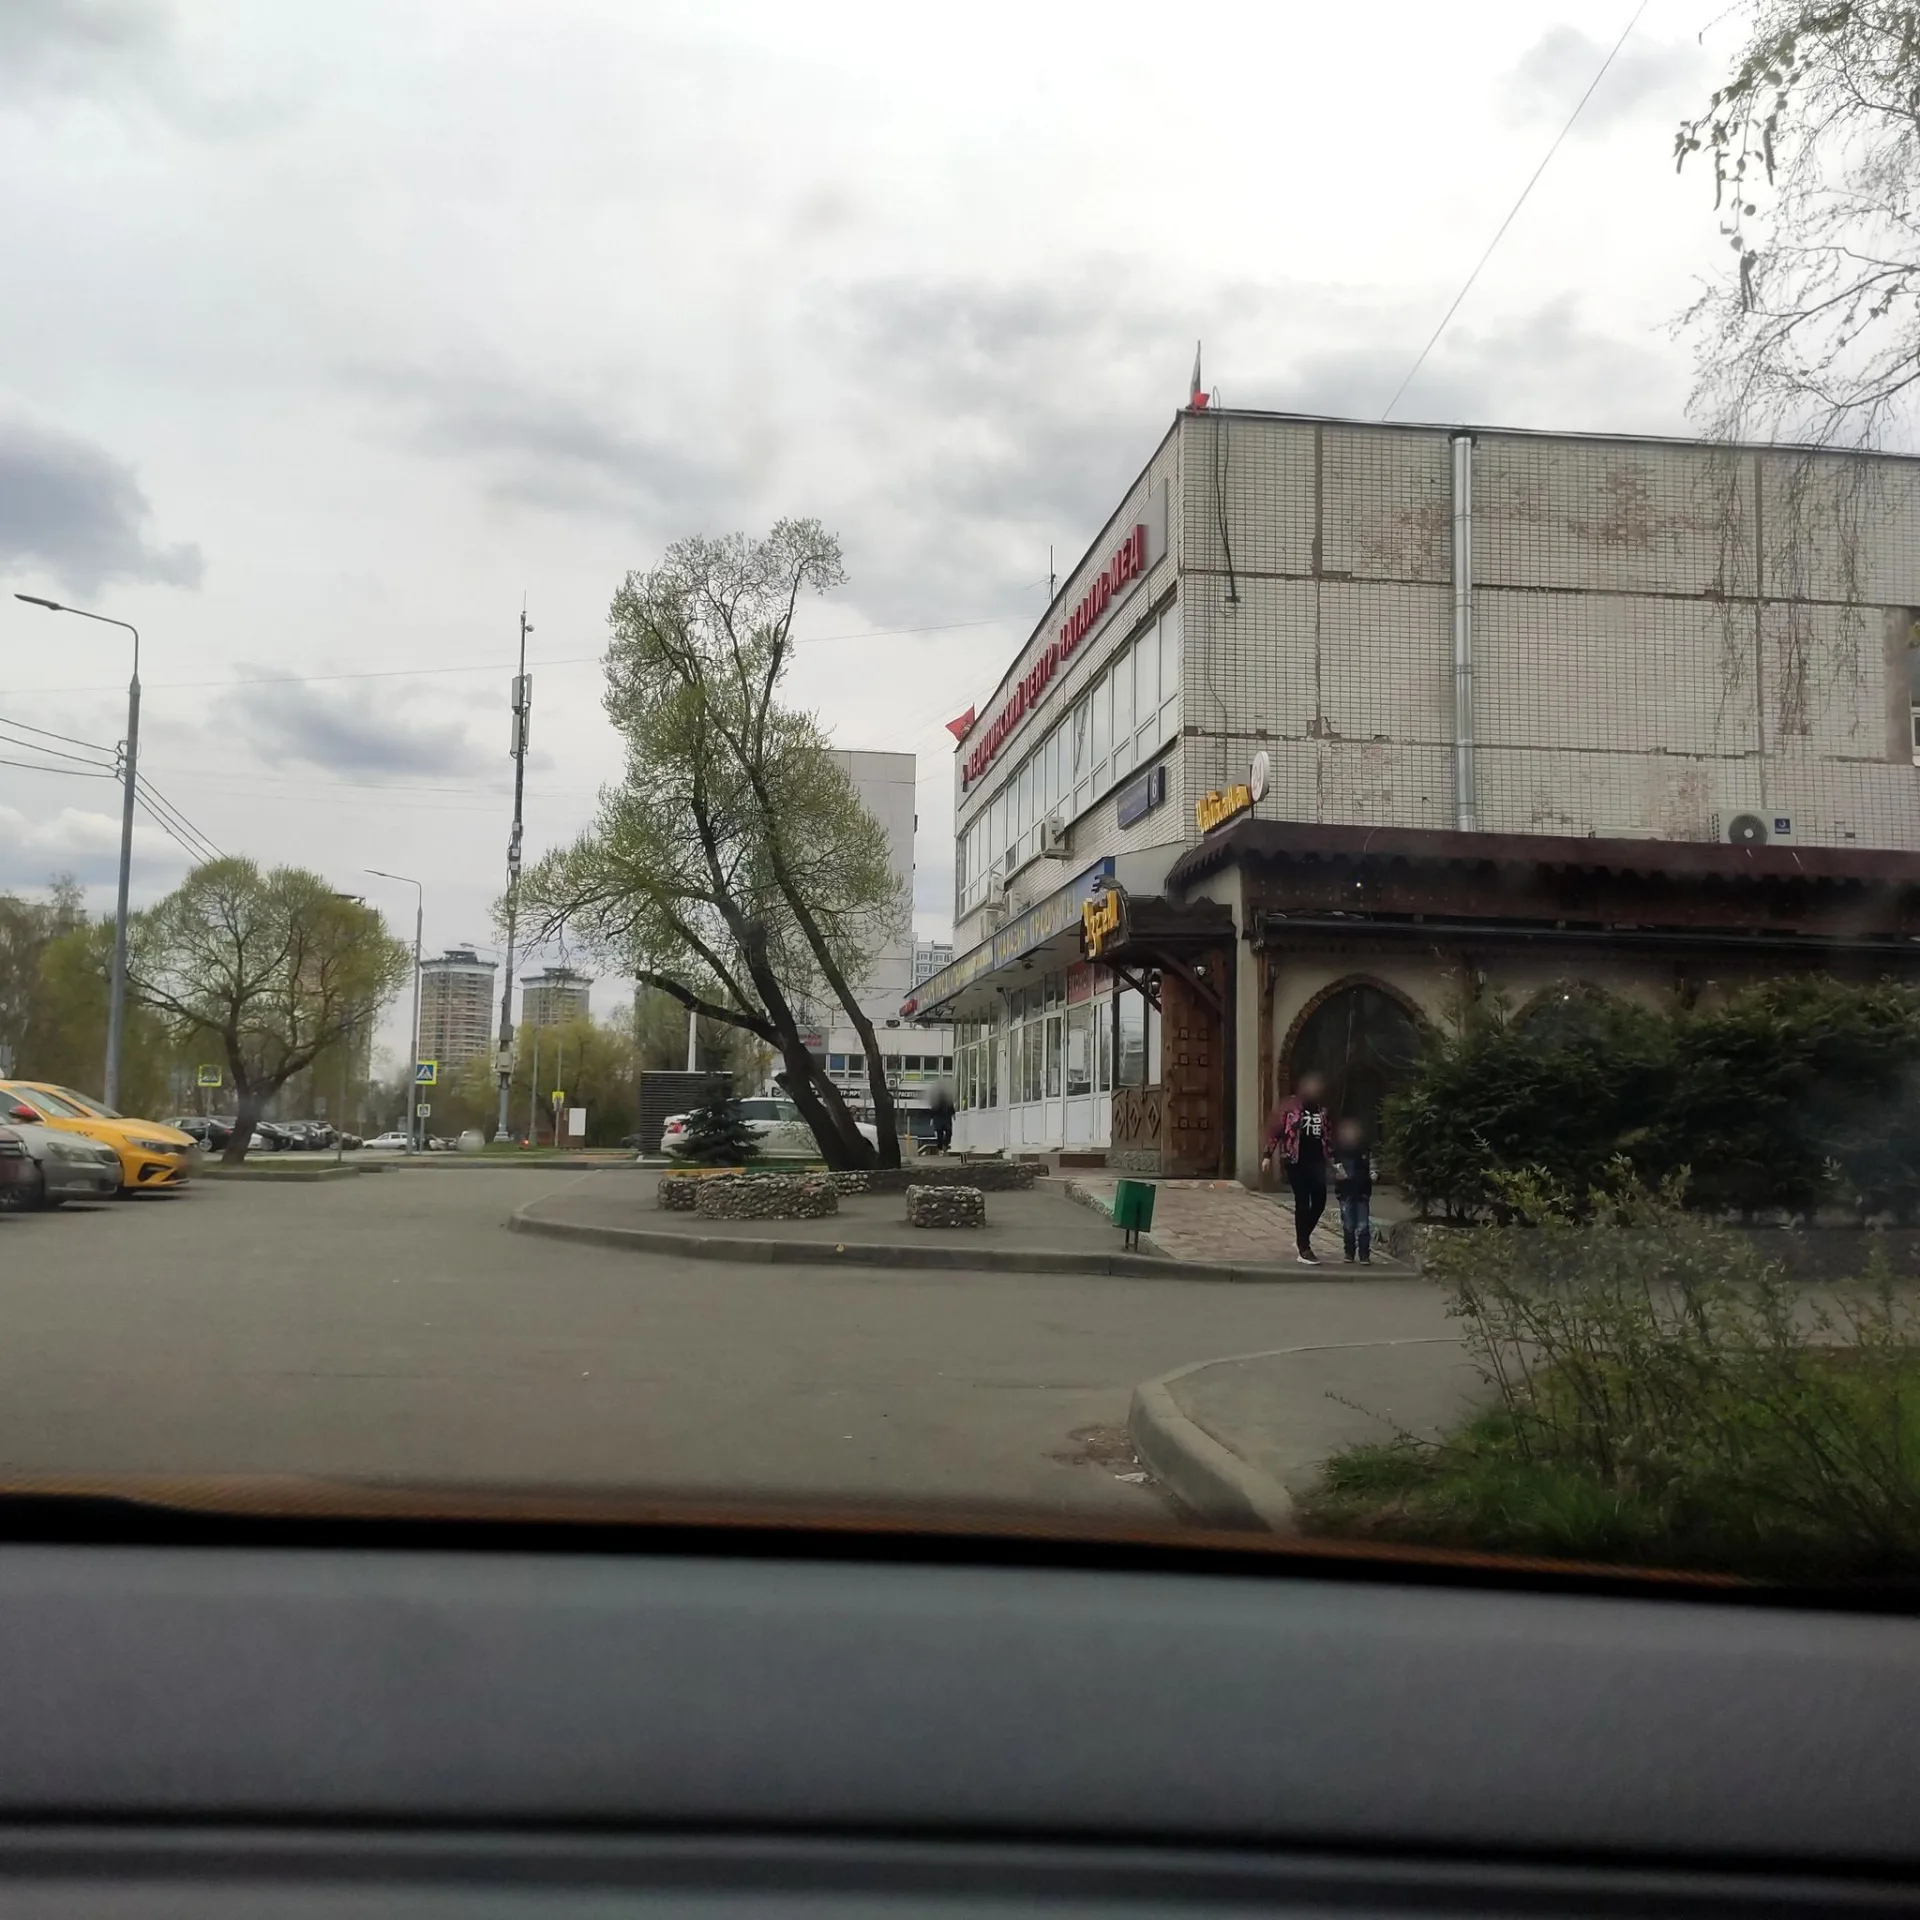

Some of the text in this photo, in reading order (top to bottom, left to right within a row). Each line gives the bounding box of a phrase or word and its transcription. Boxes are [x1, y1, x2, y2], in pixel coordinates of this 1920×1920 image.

[967, 524, 1144, 781] МЕДИЦИНСКИЙ ЦЕНТР НАТАЛИ-МЕД
[1152, 775, 1157, 798] 6
[1301, 1109, 1322, 1136] 福
